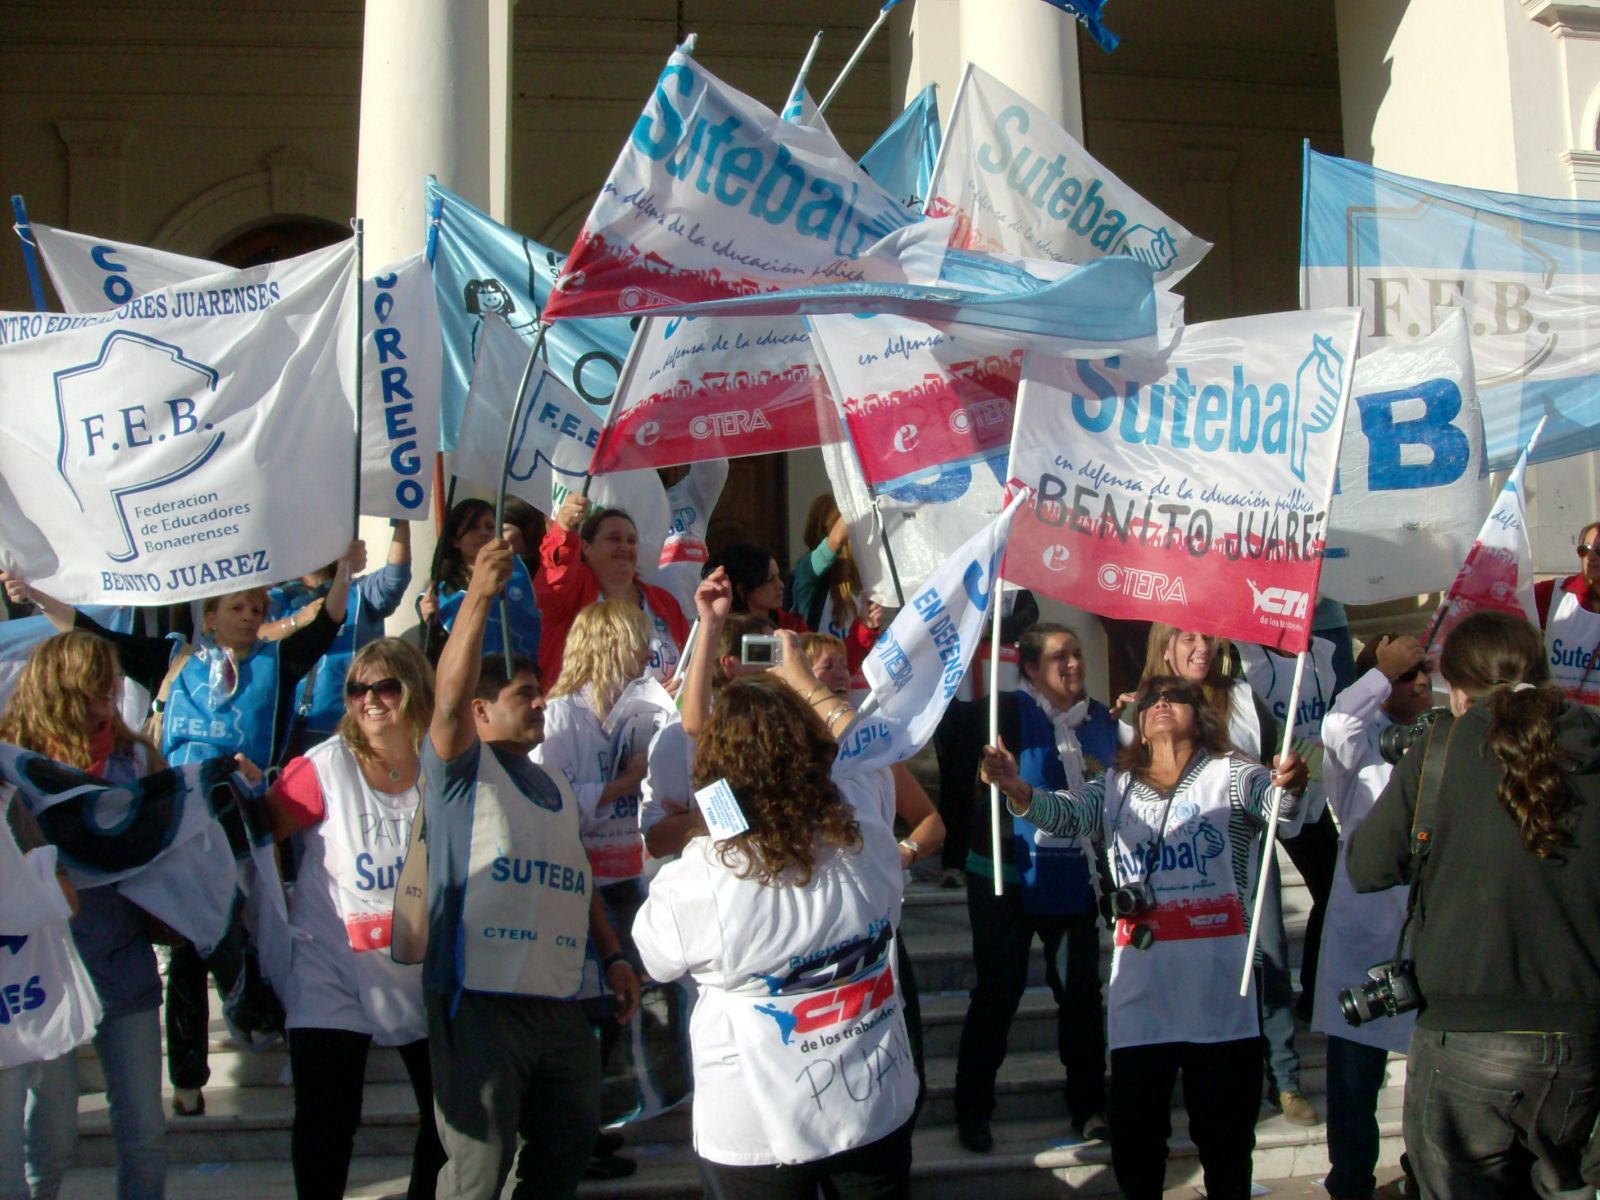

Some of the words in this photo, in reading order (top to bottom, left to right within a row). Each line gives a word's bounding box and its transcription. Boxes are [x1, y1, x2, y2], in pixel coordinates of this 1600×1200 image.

[977, 104, 1128, 253] Suteba
[668, 215, 685, 237] de
[688, 222, 706, 248] la
[711, 239, 807, 276] educación
[44, 294, 168, 334] EDUCORES
[172, 281, 281, 319] JUARENSES
[711, 334, 729, 351] de
[735, 332, 750, 349] la
[858, 354, 878, 366] en
[884, 333, 944, 360] defensa
[1071, 355, 1291, 456] Suteba
[80, 397, 215, 457] F.E.B.
[689, 408, 773, 440] CTERA
[1054, 455, 1073, 471] en
[1078, 459, 1144, 493] defensa
[1150, 476, 1171, 498] de
[1176, 478, 1193, 499] la
[1199, 483, 1270, 509] educación
[134, 491, 218, 519] Federacion
[141, 523, 158, 536] de
[161, 502, 251, 533] Educadores
[144, 523, 239, 553] Bonaerenses
[101, 571, 161, 593] BENITO
[166, 550, 270, 591] JUAREZ
[1097, 563, 1188, 607] CTERA
[1259, 615, 1269, 625] de
[1269, 617, 1279, 627] los
[1261, 586, 1309, 620] CTA
[911, 587, 945, 624] EN
[929, 617, 964, 702] DEFENSA
[171, 716, 233, 739] F.E.B.
[491, 856, 586, 897] SUTEBA
[1116, 840, 1195, 878] uteba
[555, 935, 577, 949] CTA
[801, 1039, 819, 1054] de
[820, 1033, 841, 1047] los
